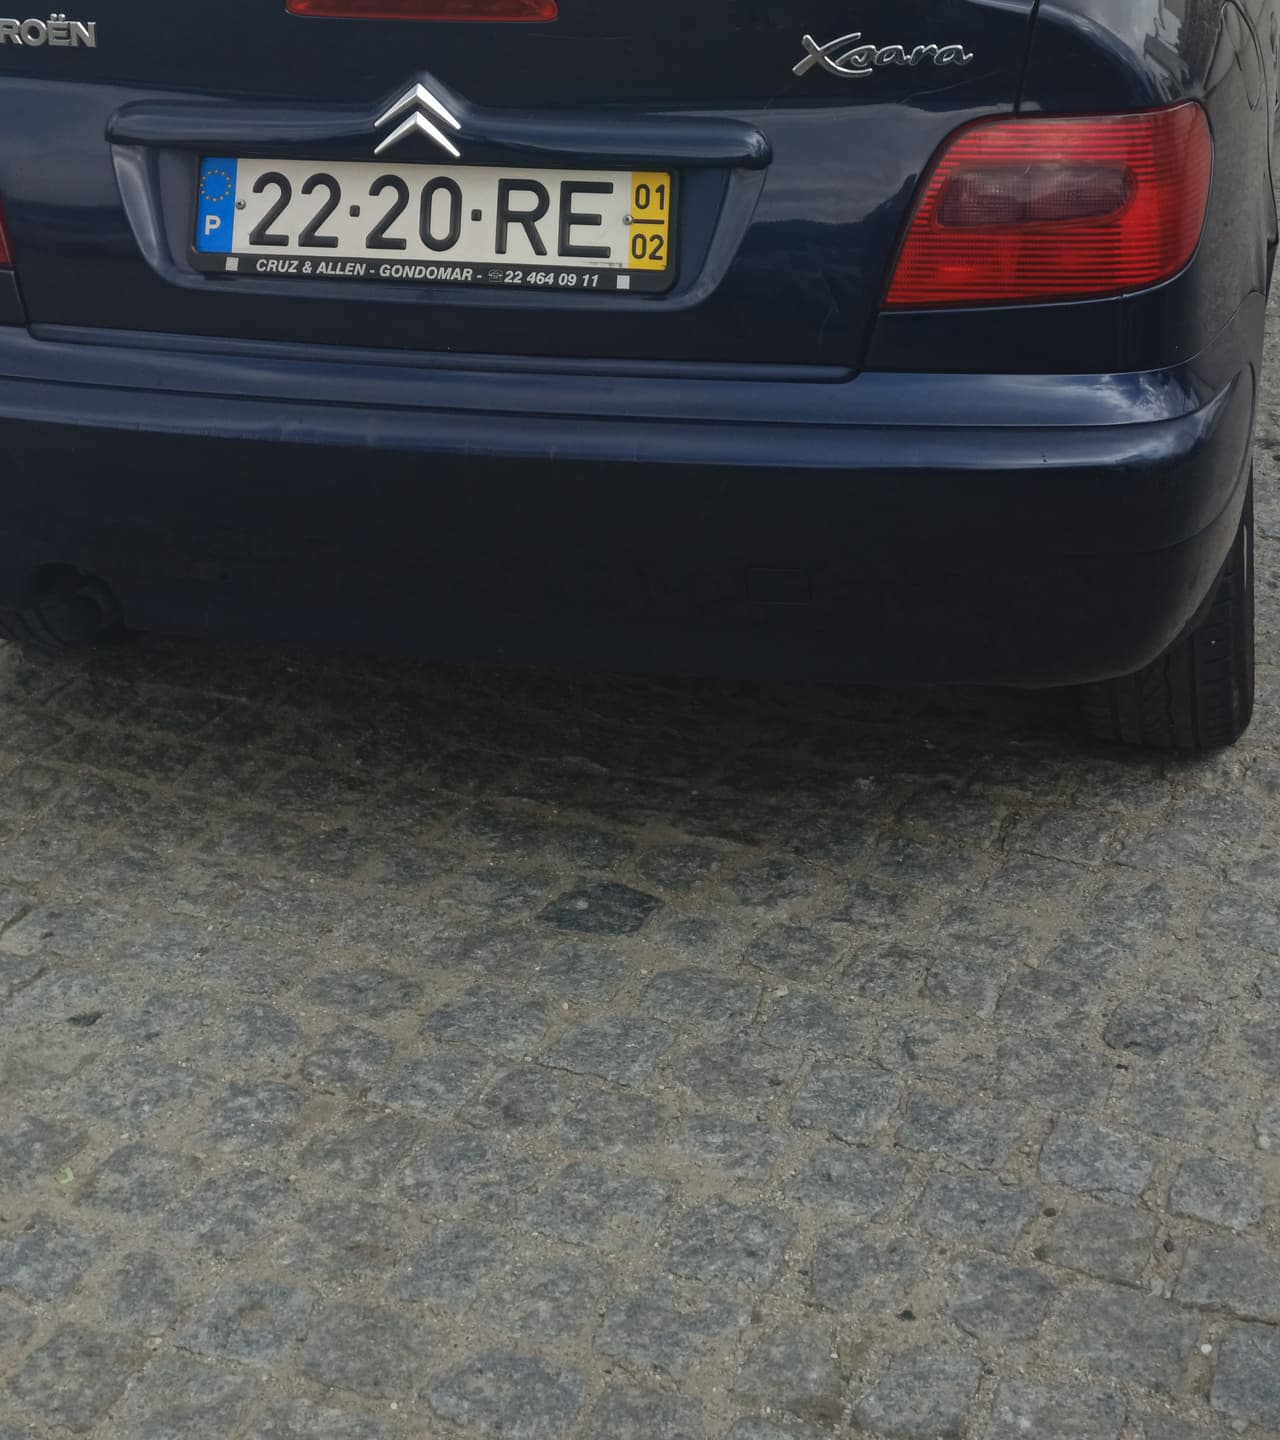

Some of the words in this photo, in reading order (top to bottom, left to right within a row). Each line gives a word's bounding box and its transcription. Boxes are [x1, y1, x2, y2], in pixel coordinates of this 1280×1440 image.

[792, 32, 973, 78] Xsara
[634, 183, 666, 211] 01
[204, 214, 221, 236] P
[631, 233, 665, 261] 02
[255, 259, 299, 274] CRUZ
[302, 261, 313, 274] &
[316, 262, 367, 277] ALLEN
[379, 264, 474, 281] GONDOMAR
[503, 270, 523, 284] 22
[527, 271, 555, 285] 464
[558, 273, 577, 286] 09
[581, 274, 599, 288] 11
